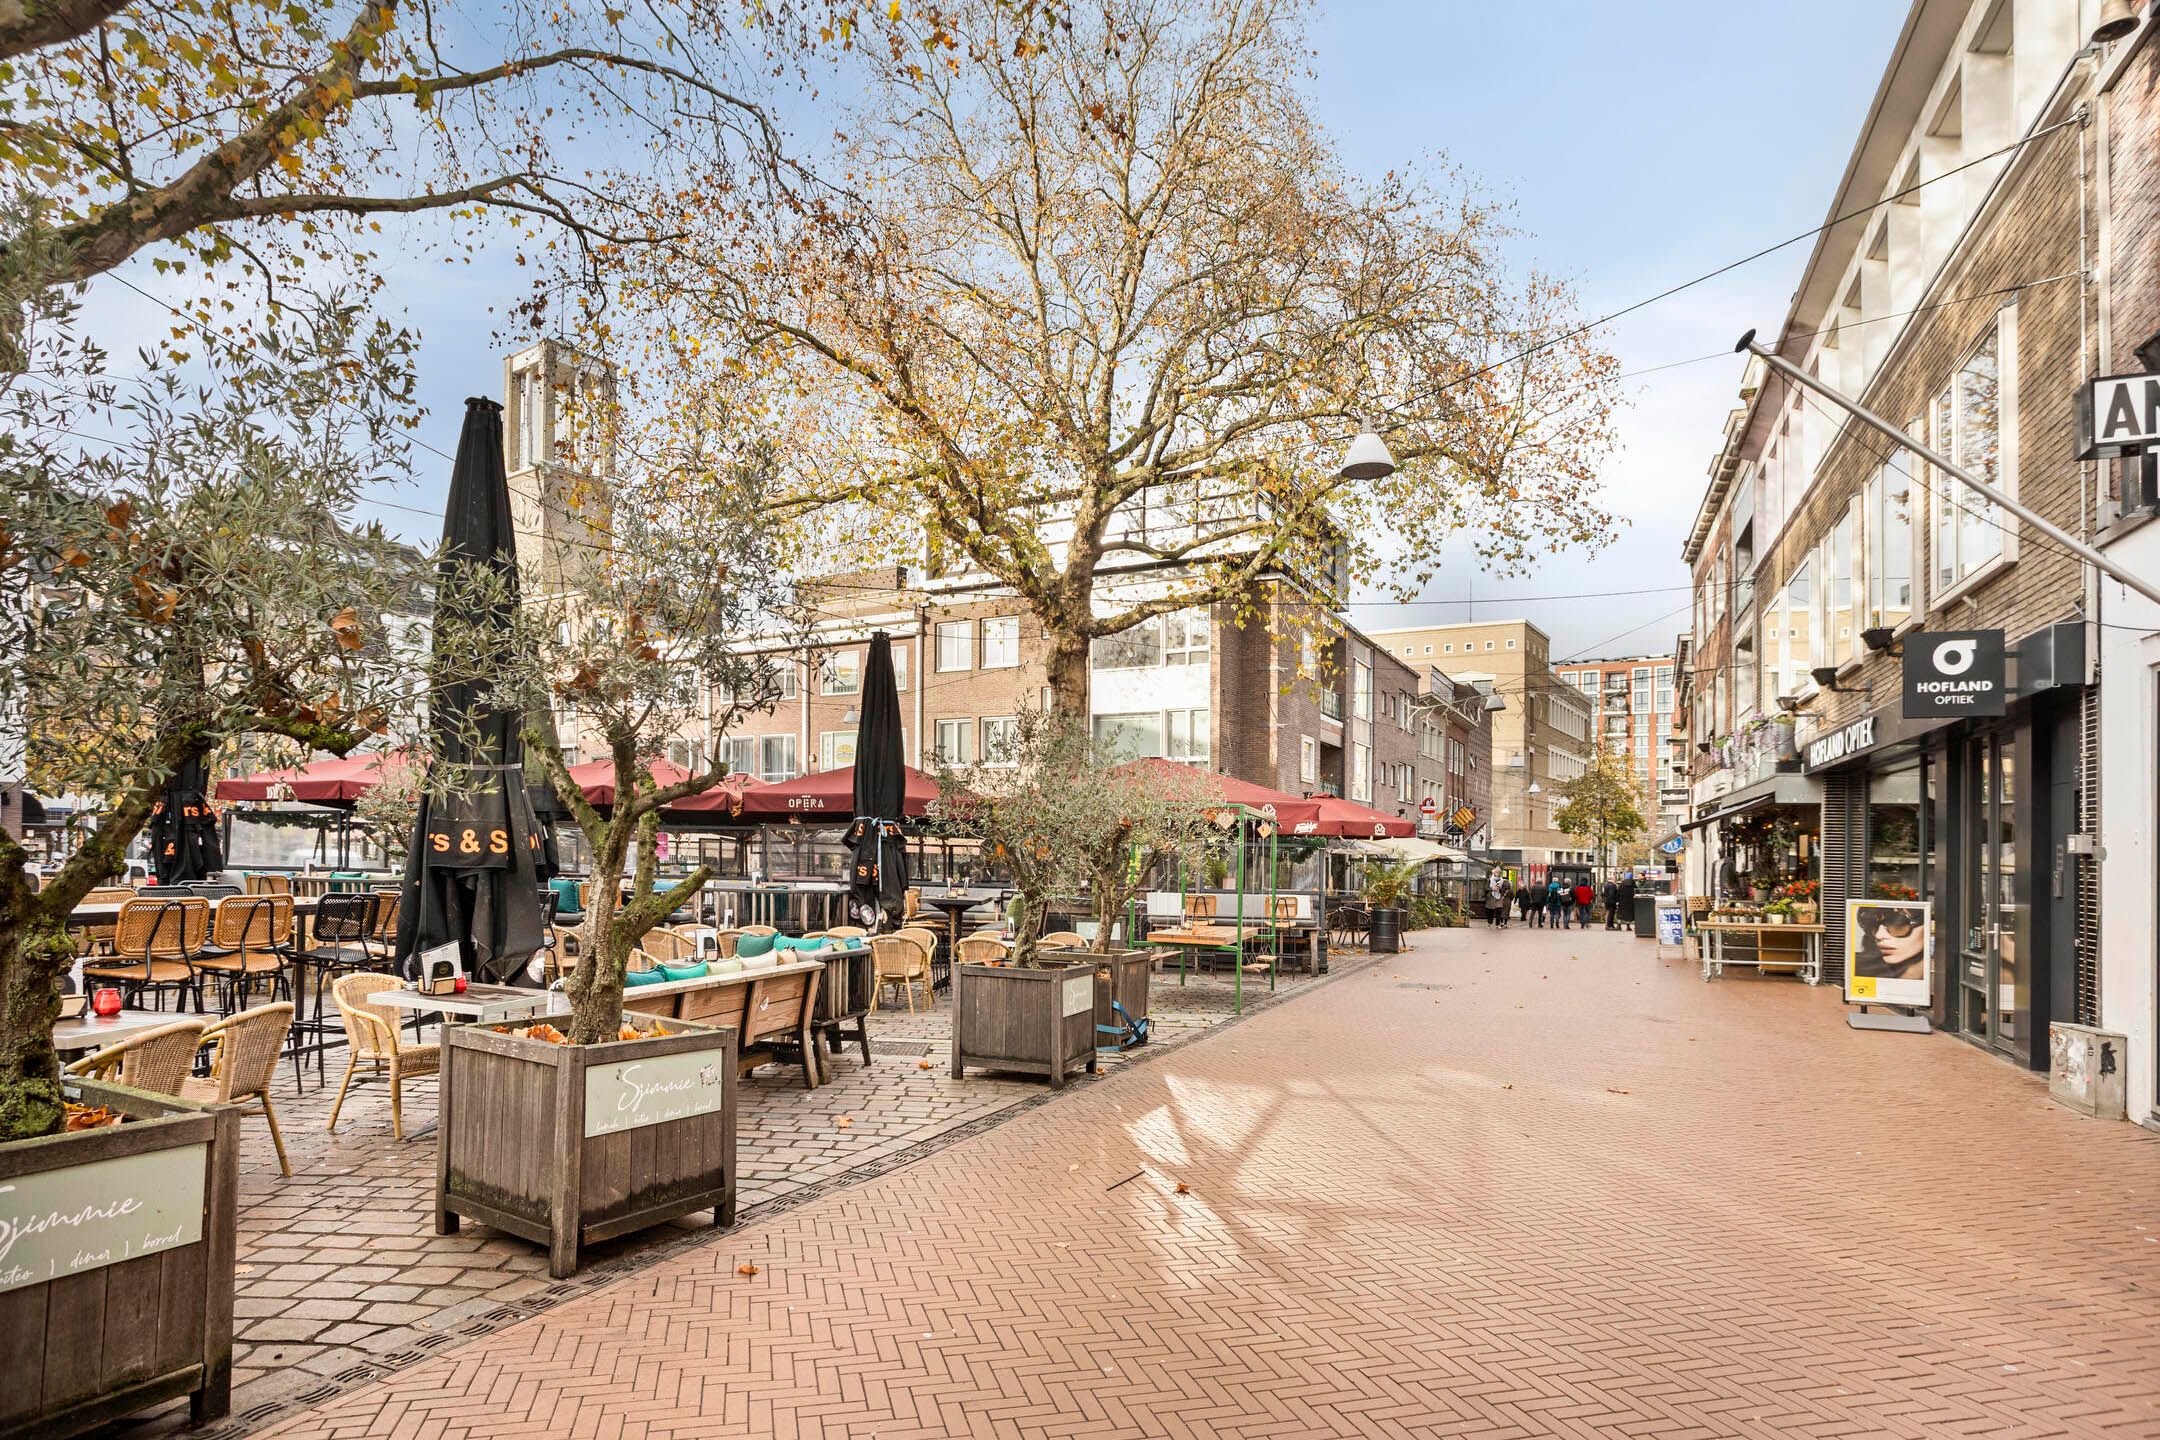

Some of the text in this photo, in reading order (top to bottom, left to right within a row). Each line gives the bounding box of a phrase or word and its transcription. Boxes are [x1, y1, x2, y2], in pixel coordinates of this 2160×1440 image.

[1917, 680, 1993, 693] HOFLAND
[1934, 695, 1975, 704] OPTIEK
[1810, 716, 1874, 767] HOFLAND OPTIEK
[788, 799, 825, 808] OPERA
[460, 829, 480, 853] &
